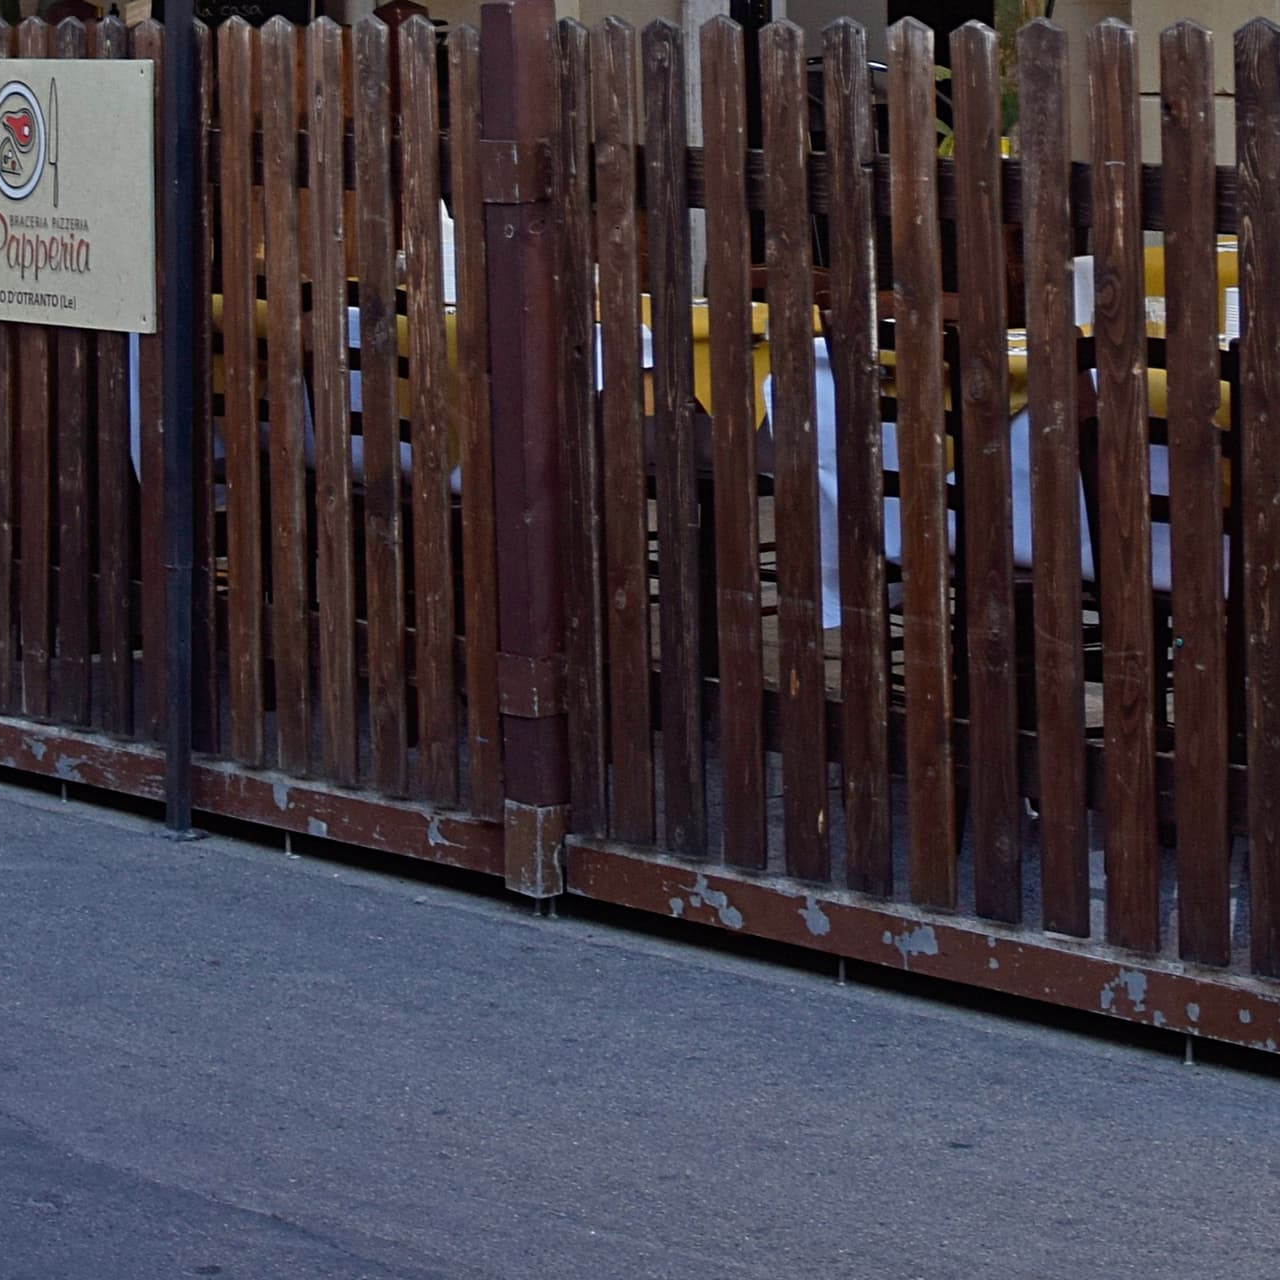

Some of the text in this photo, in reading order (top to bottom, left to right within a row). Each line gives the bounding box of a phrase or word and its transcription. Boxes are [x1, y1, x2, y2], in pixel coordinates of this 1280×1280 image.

[9, 214, 89, 232] BRACERIA PIZZERIA
[7, 290, 59, 308] D'OTRANTO
[60, 295, 77, 311] (Le)
